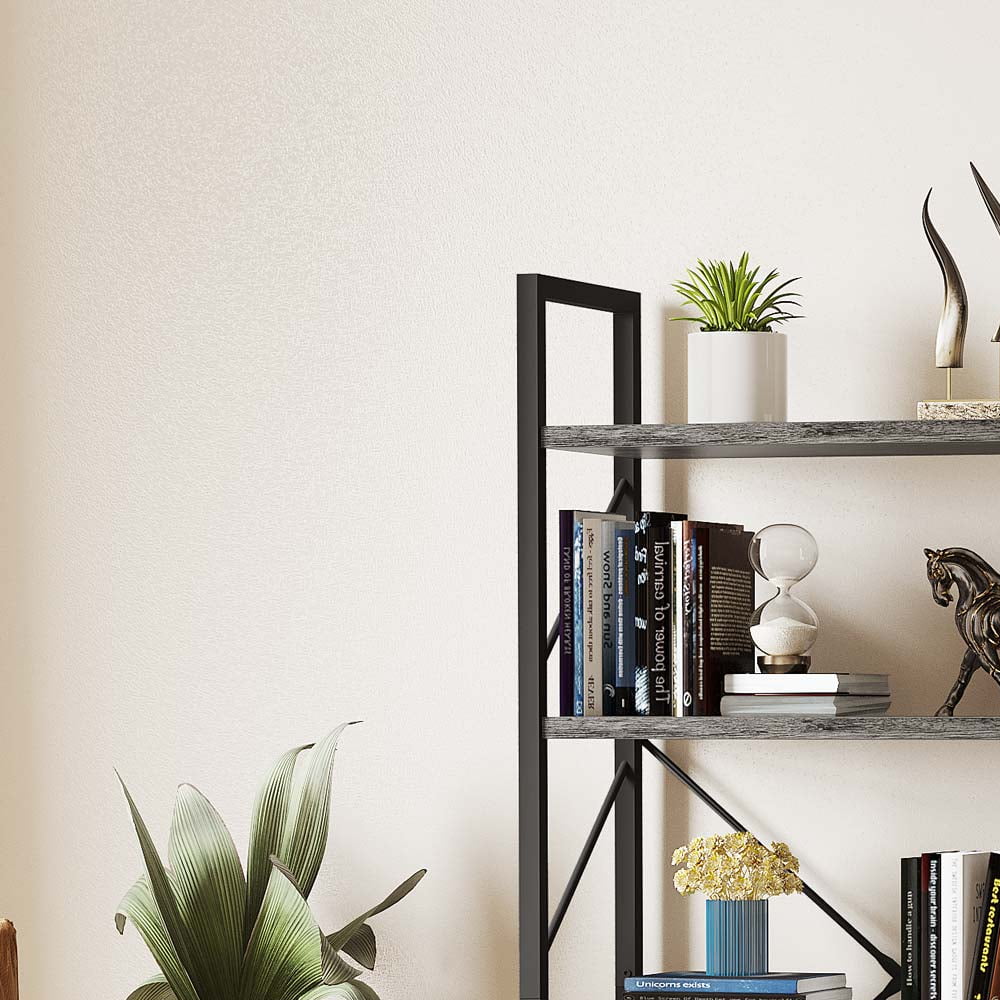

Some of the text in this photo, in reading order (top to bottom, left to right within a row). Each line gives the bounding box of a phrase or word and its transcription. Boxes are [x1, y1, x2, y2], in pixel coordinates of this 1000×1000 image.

[930, 860, 938, 884] Inside
[928, 886, 936, 905] your
[930, 906, 938, 927] brain
[930, 934, 938, 969] discover
[980, 906, 995, 973] restaurants
